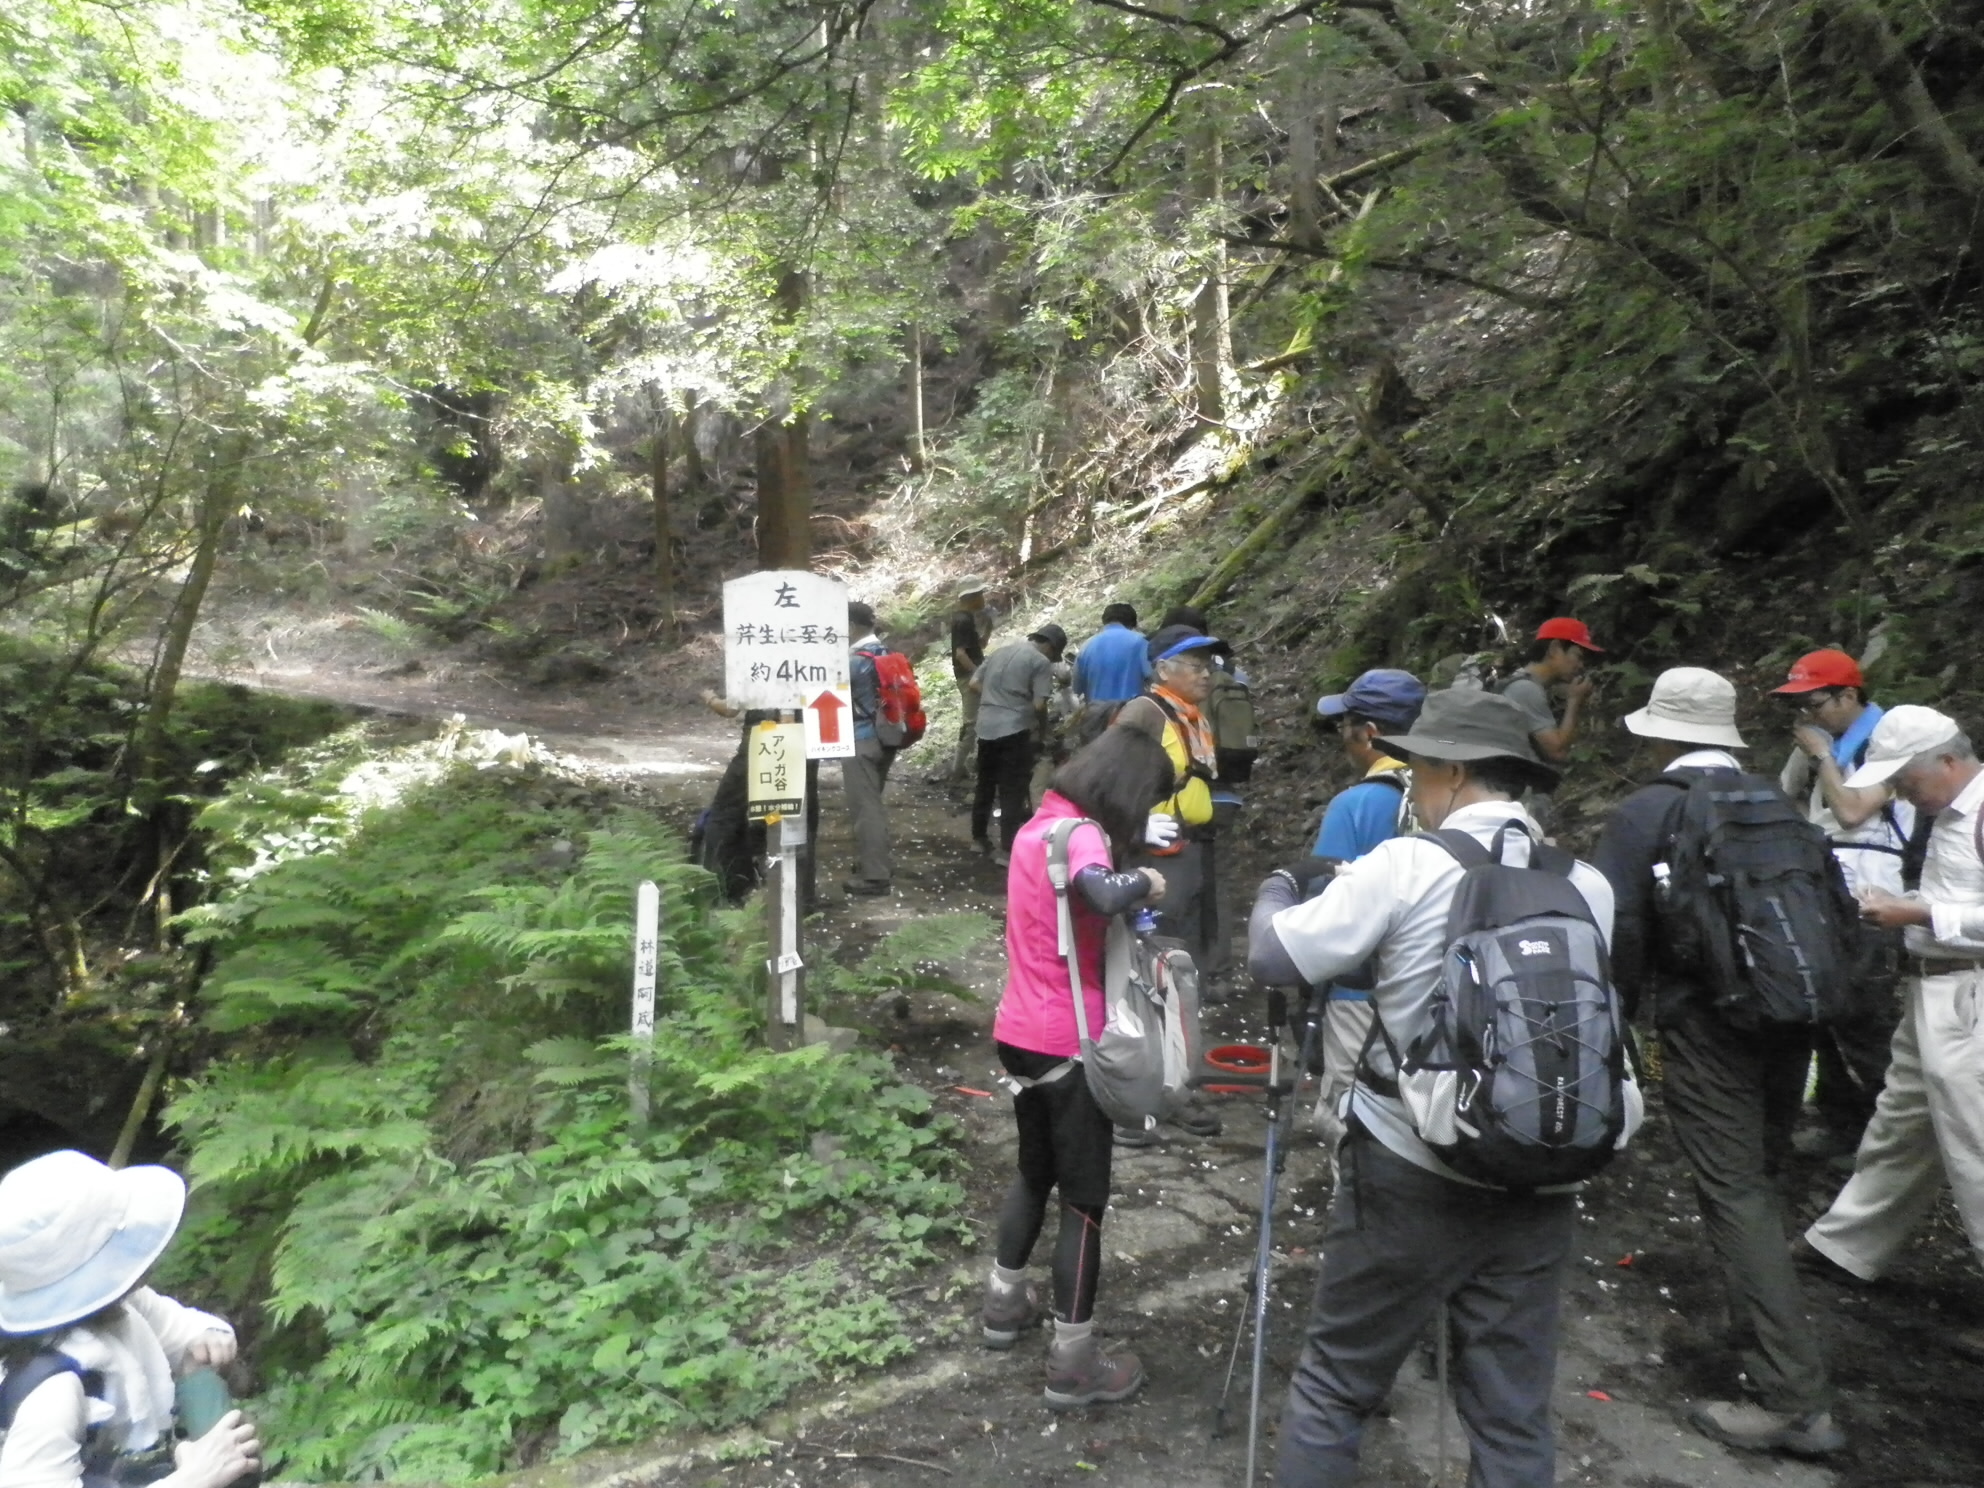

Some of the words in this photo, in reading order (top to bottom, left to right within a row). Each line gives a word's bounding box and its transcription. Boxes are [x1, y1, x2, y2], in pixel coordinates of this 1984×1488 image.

[774, 581, 801, 608] 左
[736, 623, 838, 645] 芹生に至る
[758, 742, 772, 784] 入口
